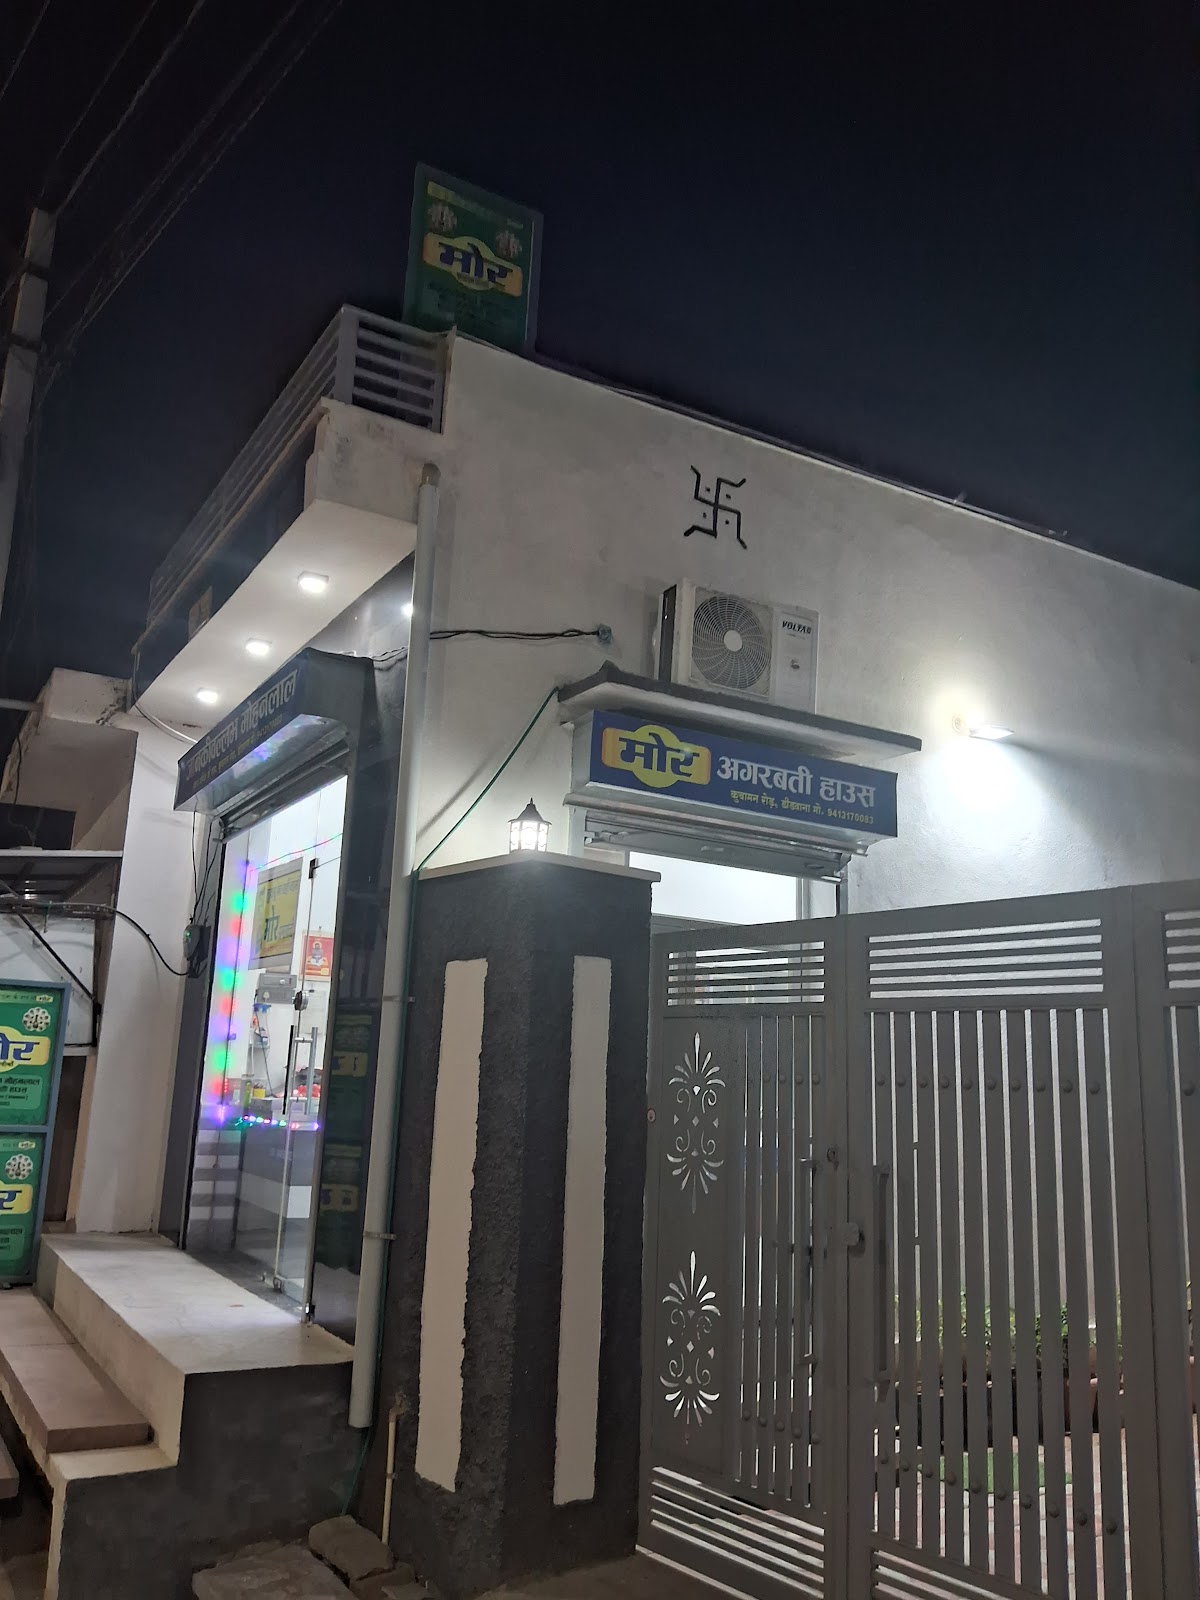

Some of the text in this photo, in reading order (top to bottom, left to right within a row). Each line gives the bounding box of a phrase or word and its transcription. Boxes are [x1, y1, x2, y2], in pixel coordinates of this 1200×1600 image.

[438, 242, 513, 286] मोर
[241, 669, 298, 734] मोहनलाल
[618, 732, 700, 777] मोर
[716, 756, 876, 808] अगरबती हाउस
[730, 789, 759, 804] कुचामन
[827, 807, 875, 825] 9413170083
